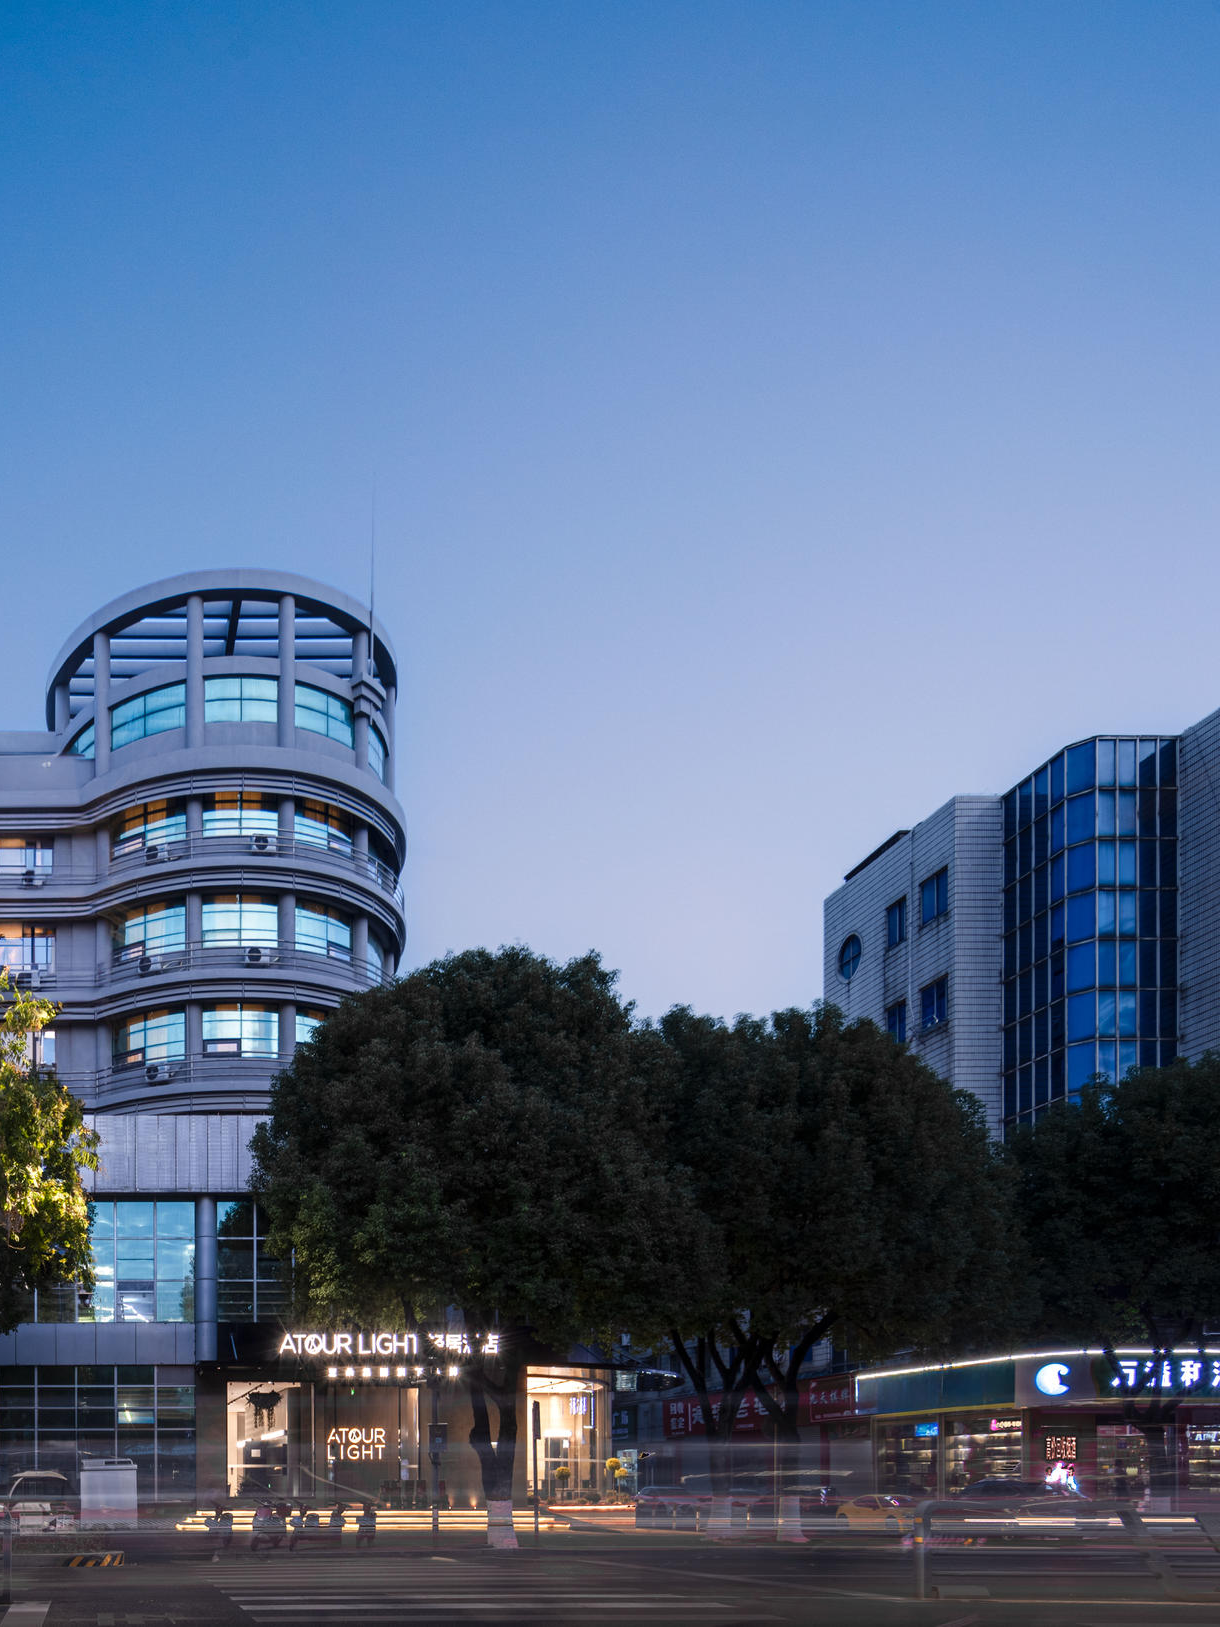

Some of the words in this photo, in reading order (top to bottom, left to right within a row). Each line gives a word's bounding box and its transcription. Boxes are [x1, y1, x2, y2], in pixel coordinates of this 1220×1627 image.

[279, 1333, 353, 1355] ATOUR
[357, 1333, 418, 1355] LIGHT
[327, 1428, 386, 1444] ATOUR
[327, 1444, 386, 1460] LIGHT
